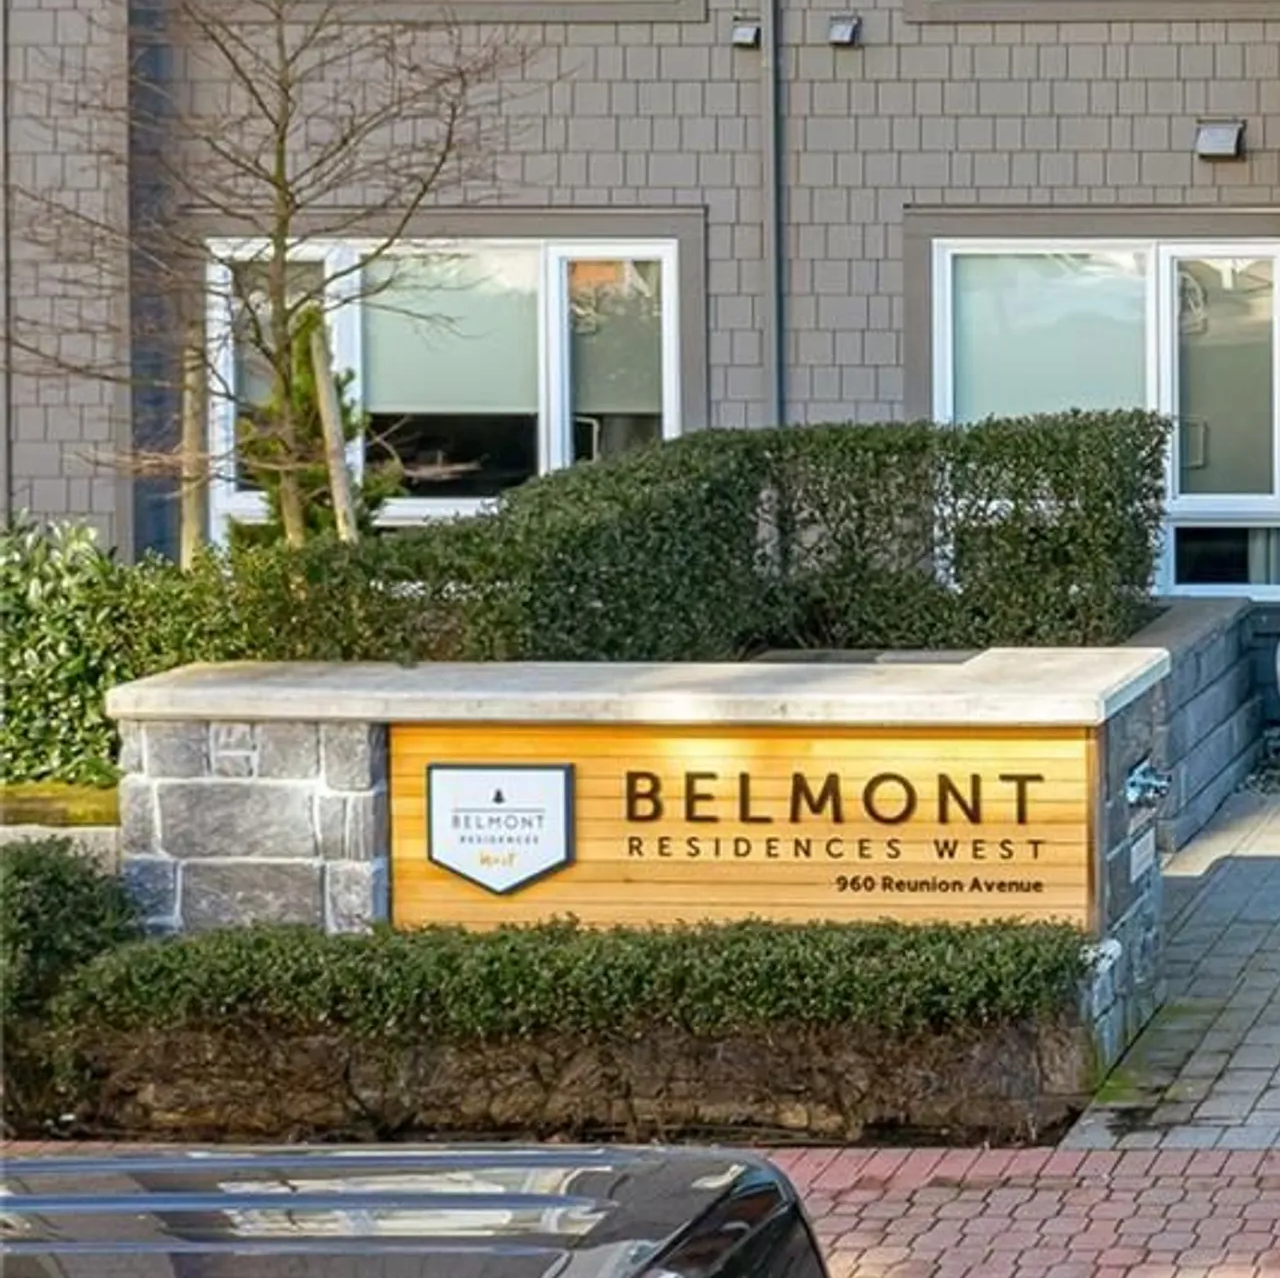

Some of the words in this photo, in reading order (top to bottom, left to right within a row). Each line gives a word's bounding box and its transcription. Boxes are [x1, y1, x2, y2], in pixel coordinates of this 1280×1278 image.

[625, 771, 1045, 825] BELMONT
[452, 814, 544, 829] BELMONT
[628, 836, 901, 859] RESIDENCES
[933, 837, 1046, 860] WEST
[836, 875, 875, 892] 960
[881, 875, 965, 893] Reunion
[969, 876, 1044, 893] Avenue
